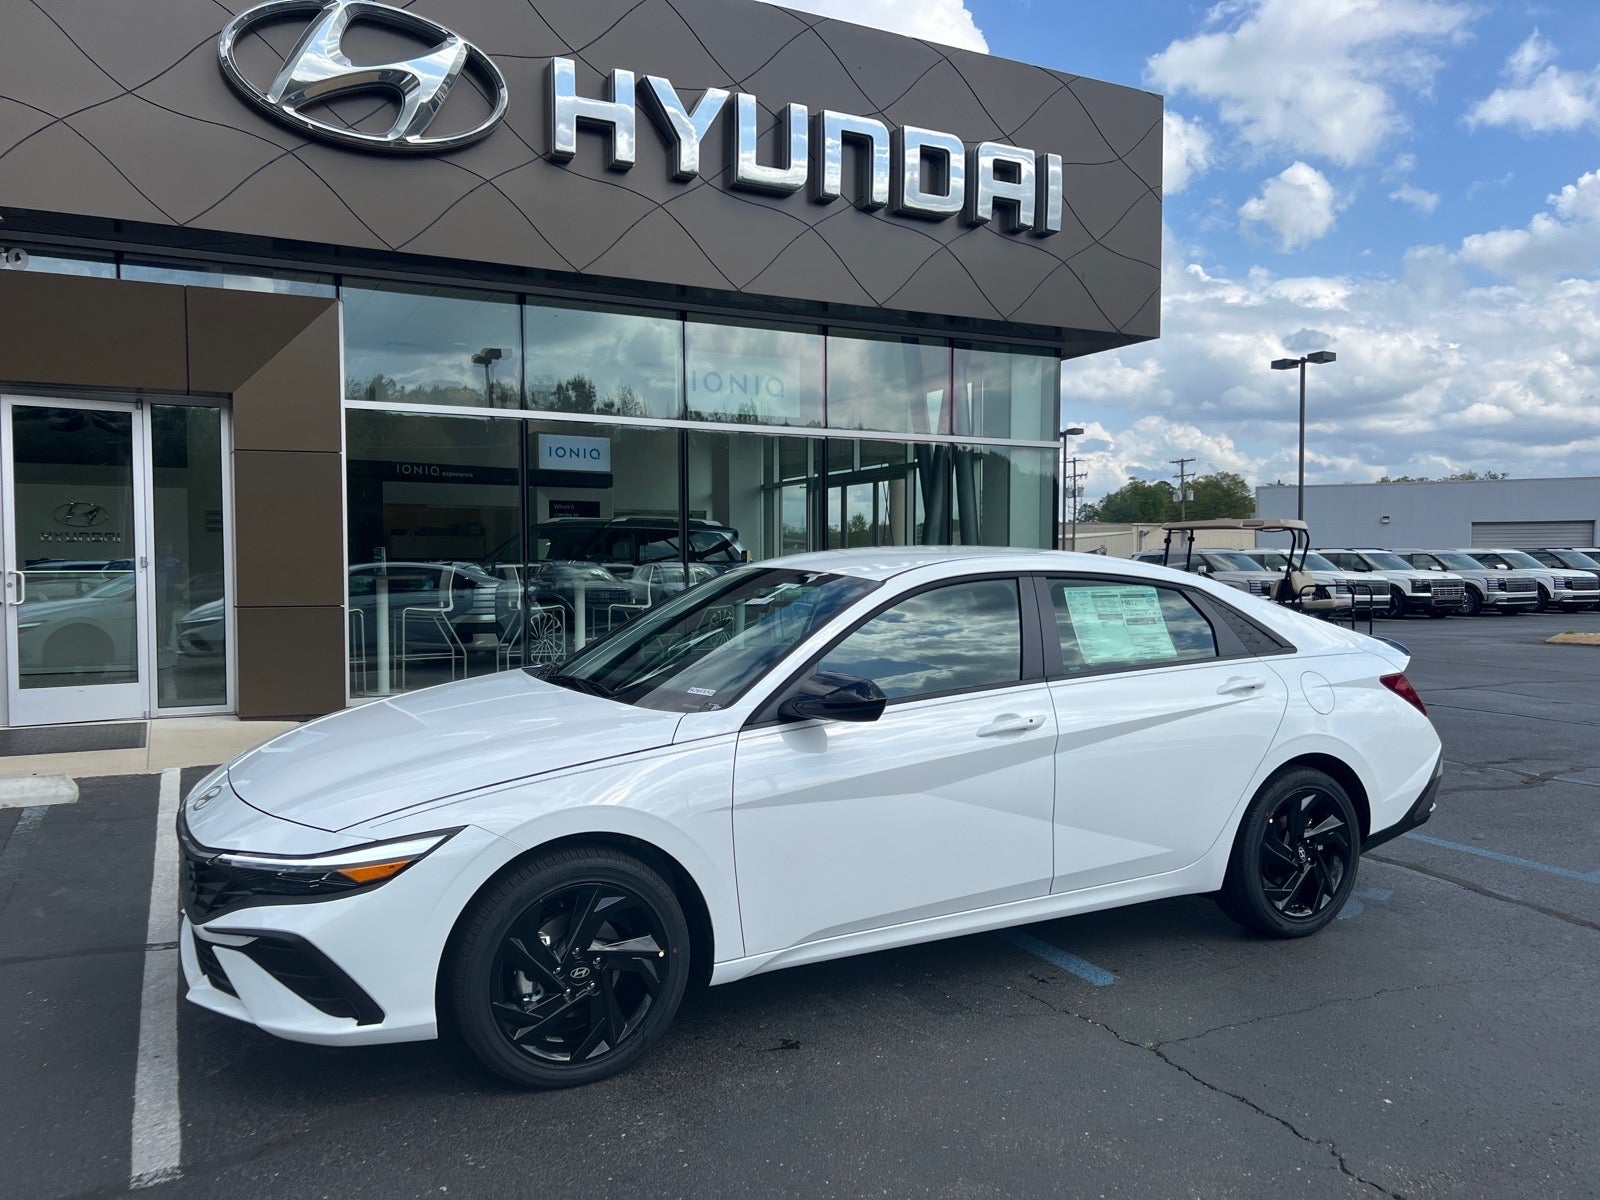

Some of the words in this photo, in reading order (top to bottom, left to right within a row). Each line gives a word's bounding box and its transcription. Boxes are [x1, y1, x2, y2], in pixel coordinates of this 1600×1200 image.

[547, 57, 1063, 236] HYUNDAI
[692, 370, 784, 398] IONIQ
[548, 446, 600, 460] IONIQ
[396, 464, 440, 476] IONIQ
[40, 532, 120, 543] HYUNDAI
